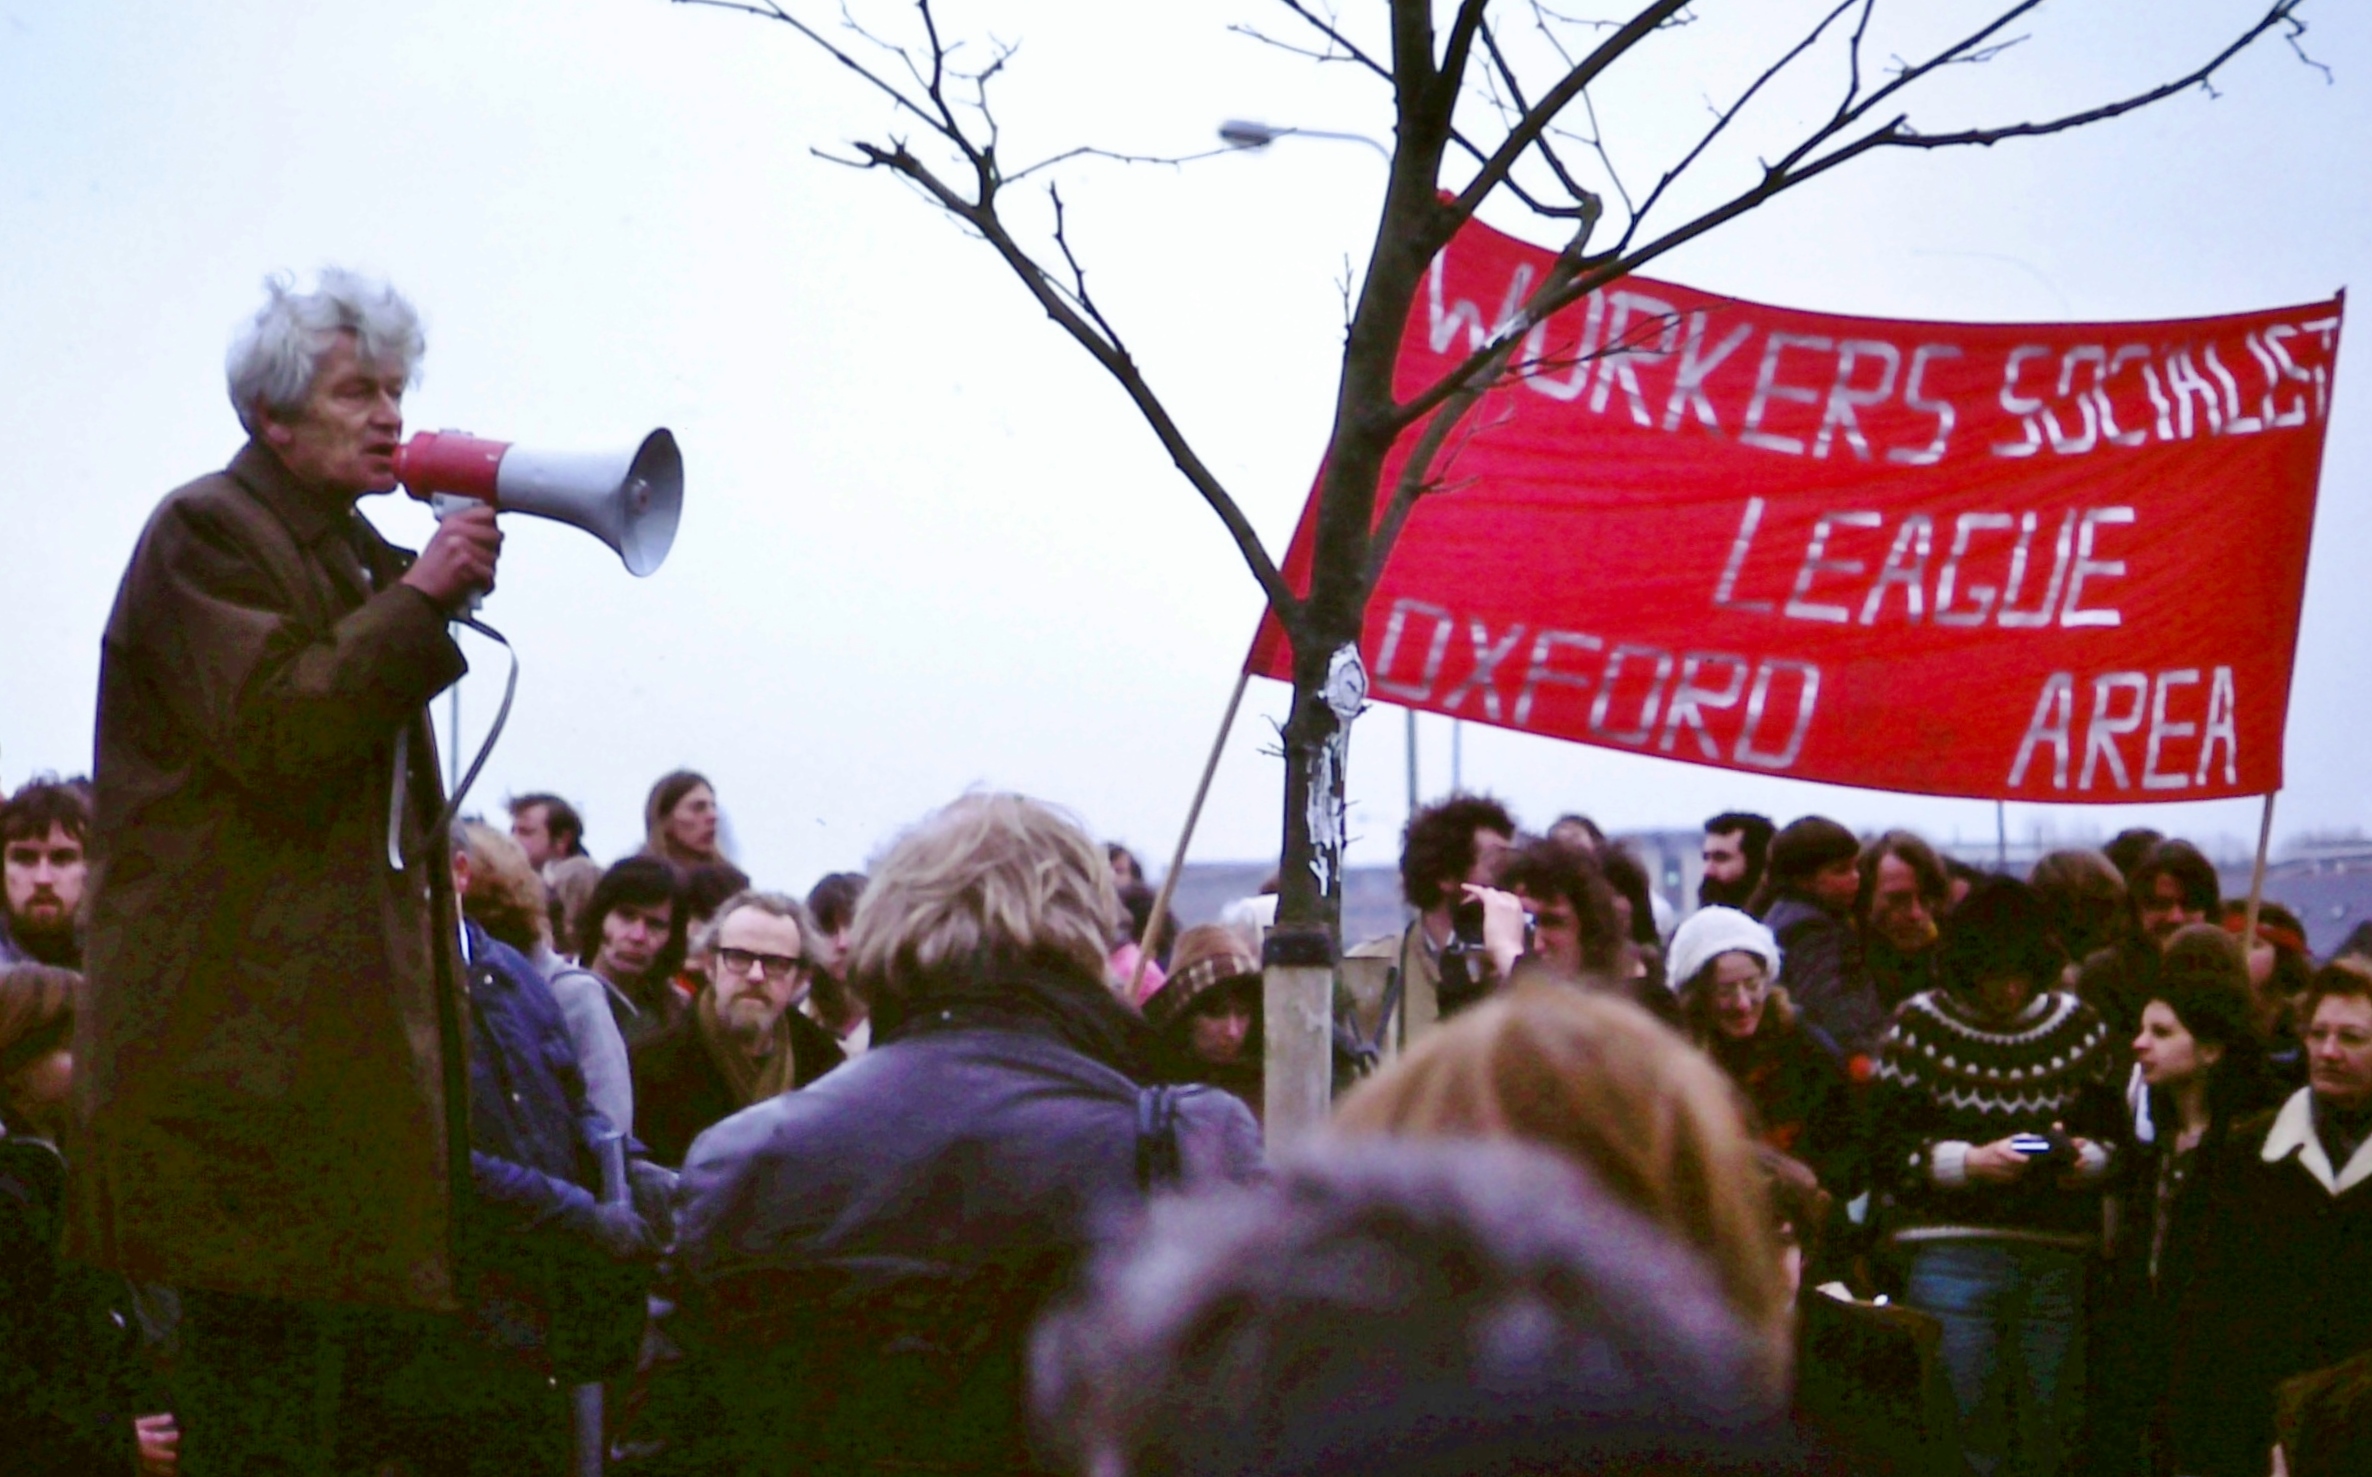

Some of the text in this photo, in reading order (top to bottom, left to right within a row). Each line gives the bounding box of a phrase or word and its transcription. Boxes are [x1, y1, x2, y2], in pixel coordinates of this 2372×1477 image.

[1429, 248, 2338, 464] WORKERS SOCIALIST
[1713, 497, 2134, 626] LEAGUE
[1374, 599, 2237, 790] OXFORD AREA
